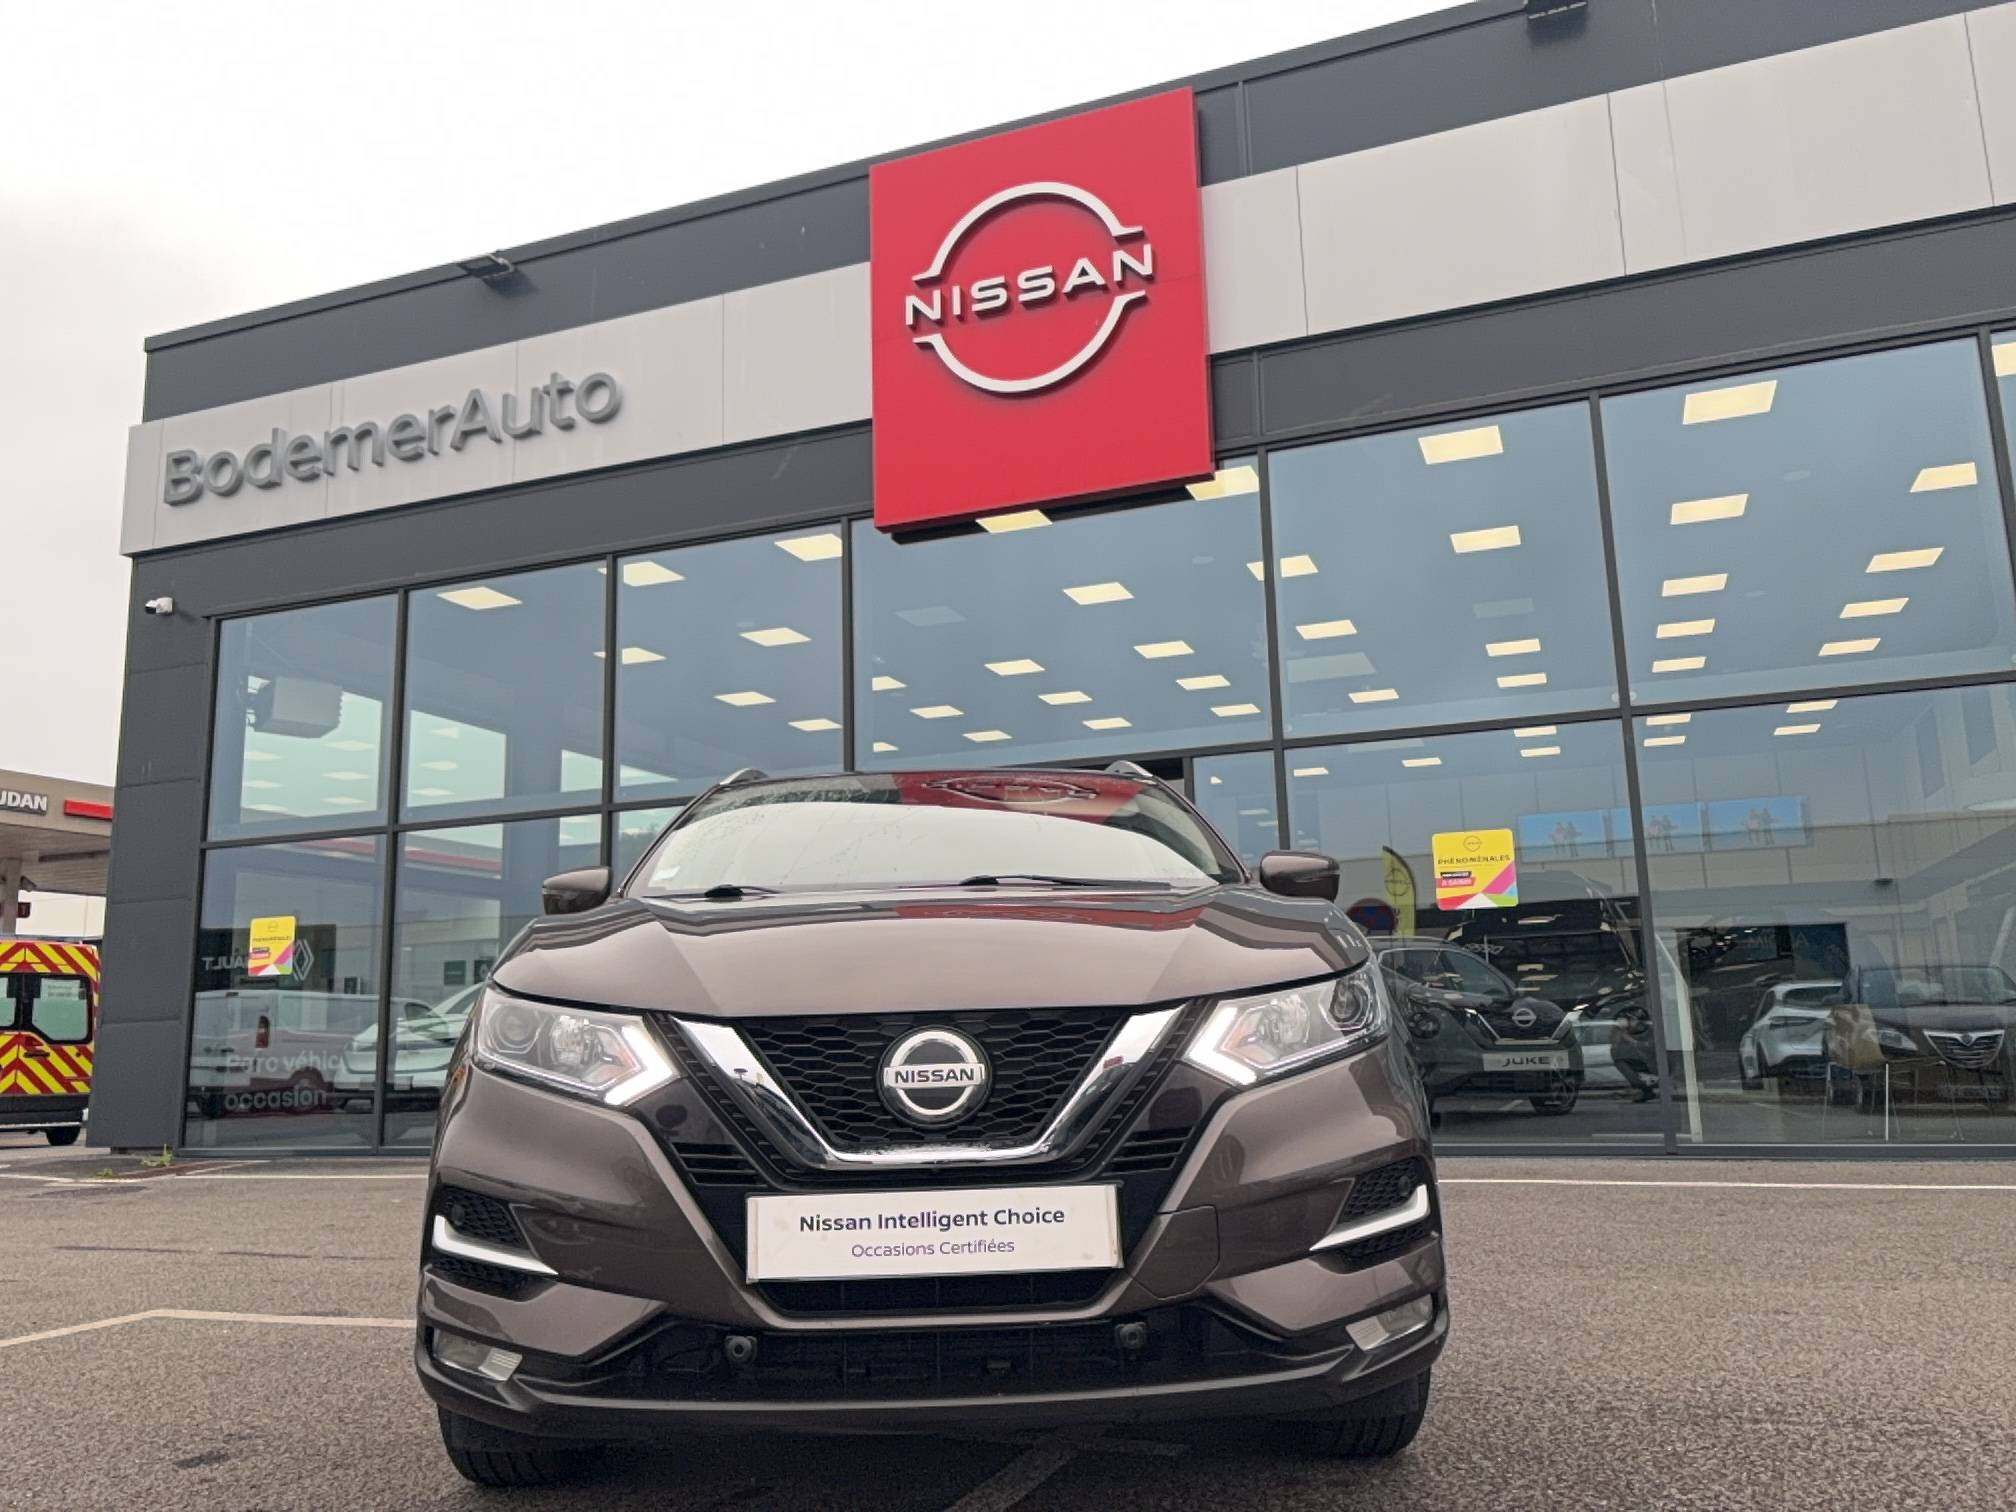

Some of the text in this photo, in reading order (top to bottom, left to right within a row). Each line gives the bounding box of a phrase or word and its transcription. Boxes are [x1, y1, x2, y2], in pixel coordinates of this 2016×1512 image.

[905, 243, 1154, 328] NISSAN
[163, 371, 623, 506] BodemerAuto
[894, 1067, 975, 1084] NISSAN
[1502, 1056, 1551, 1068] JUKE
[224, 1084, 327, 1111] occasion
[799, 1206, 1066, 1234] Nissan Intelligent Choice
[851, 1238, 1016, 1259] Occasions Certifiées
